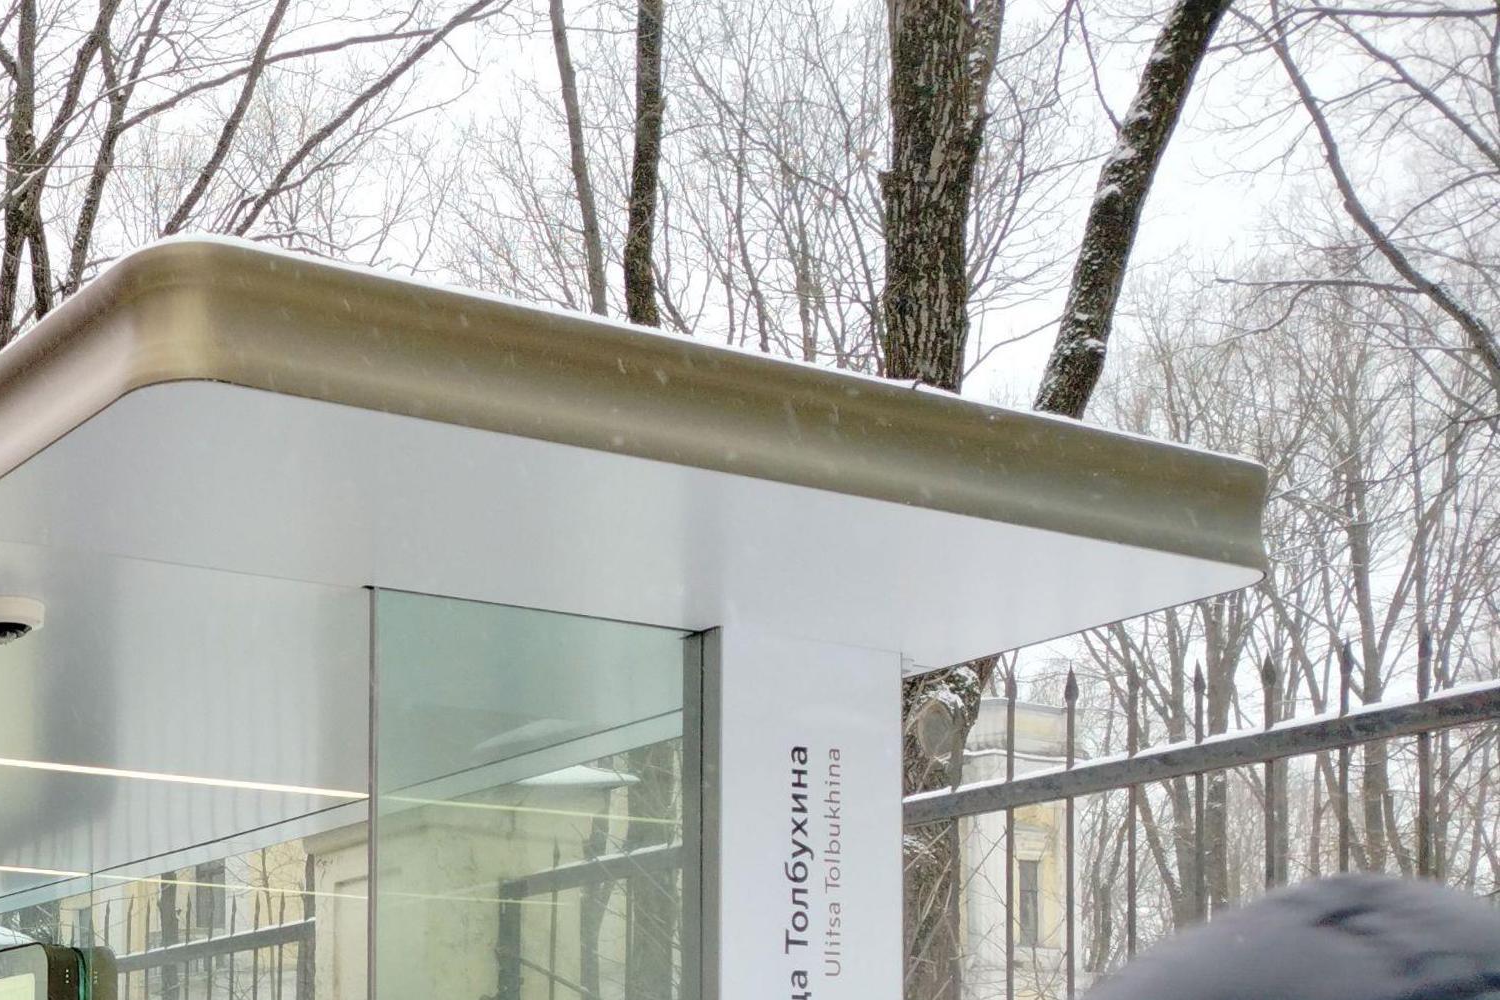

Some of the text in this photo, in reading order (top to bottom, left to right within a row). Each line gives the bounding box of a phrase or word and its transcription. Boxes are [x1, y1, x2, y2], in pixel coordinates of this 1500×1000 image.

[784, 746, 814, 954] Толбухина
[824, 747, 841, 977] Ulitsa Tolbukhina
